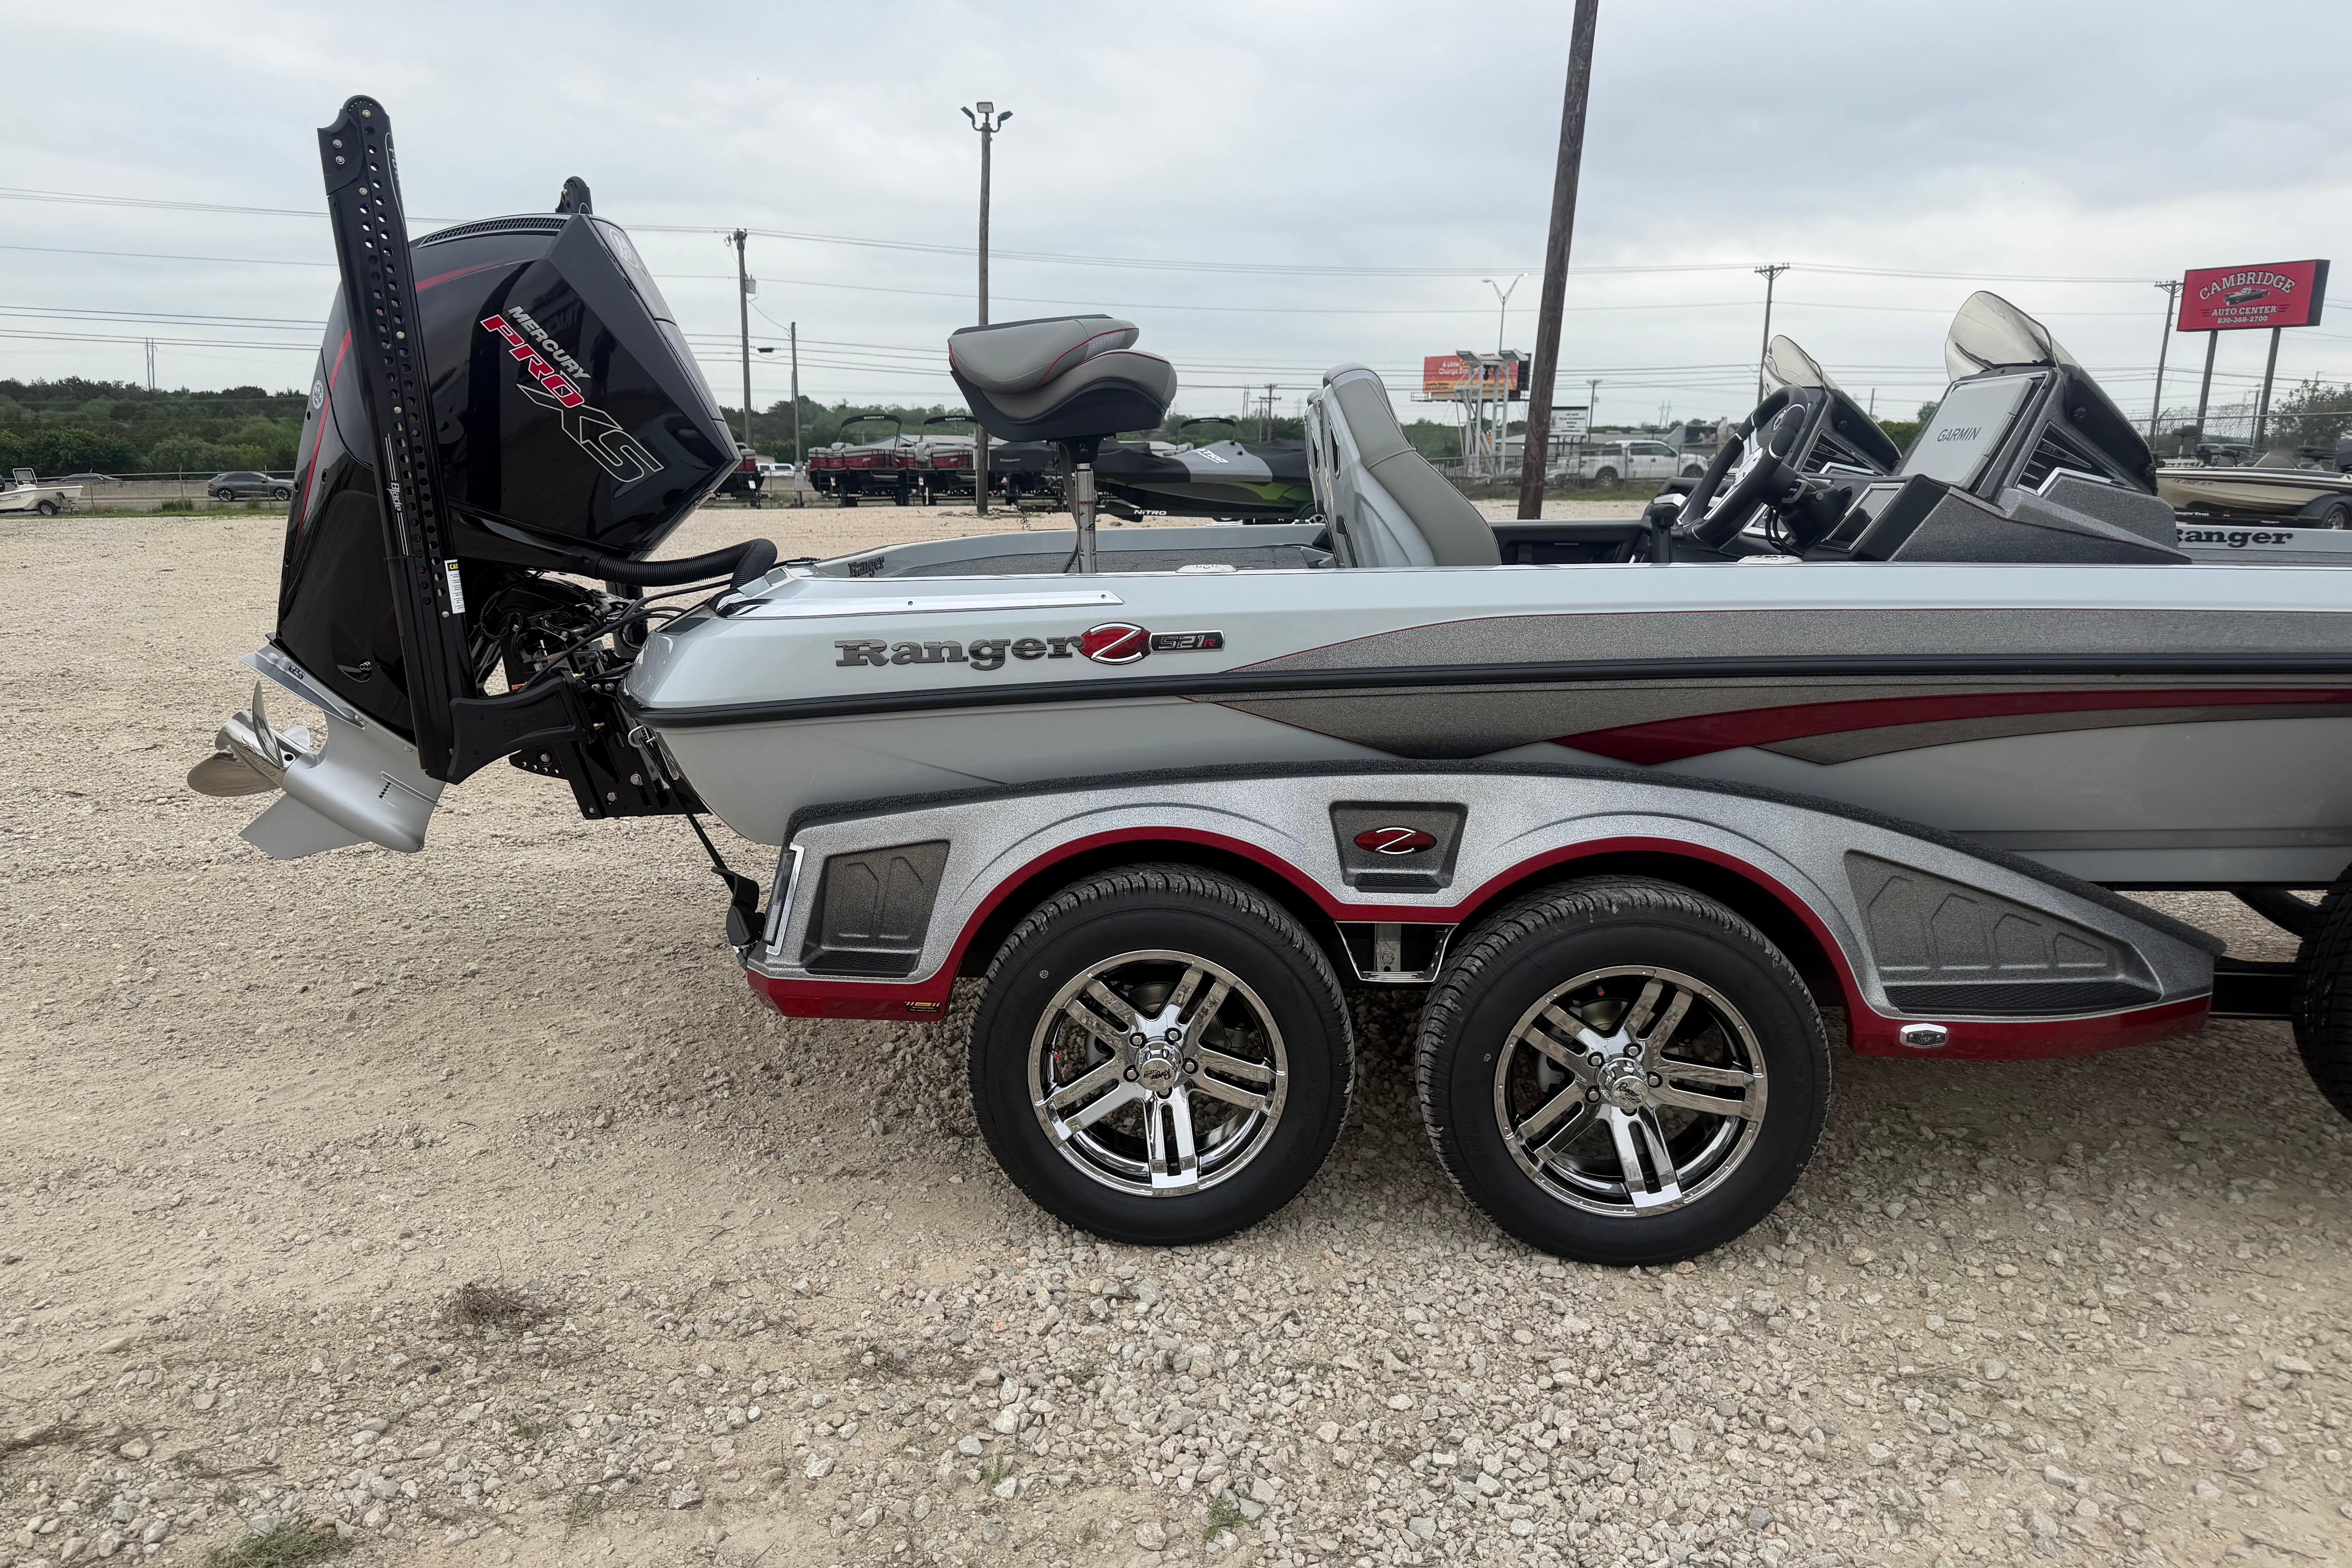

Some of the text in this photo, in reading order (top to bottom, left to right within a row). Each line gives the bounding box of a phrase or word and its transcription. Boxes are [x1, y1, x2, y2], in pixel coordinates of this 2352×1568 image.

[2199, 271, 2296, 300] CAMBRIDGE
[2212, 306, 2277, 316] AUTO CENTER
[508, 306, 591, 379] MERCURY
[480, 314, 585, 408] PRO
[516, 370, 664, 483] XS
[1937, 427, 1981, 442] GARMIN
[386, 482, 402, 511] Blade
[848, 556, 884, 577] Ranger
[834, 622, 1217, 671] Ranger Z 521R
[1375, 827, 1417, 855] Z
